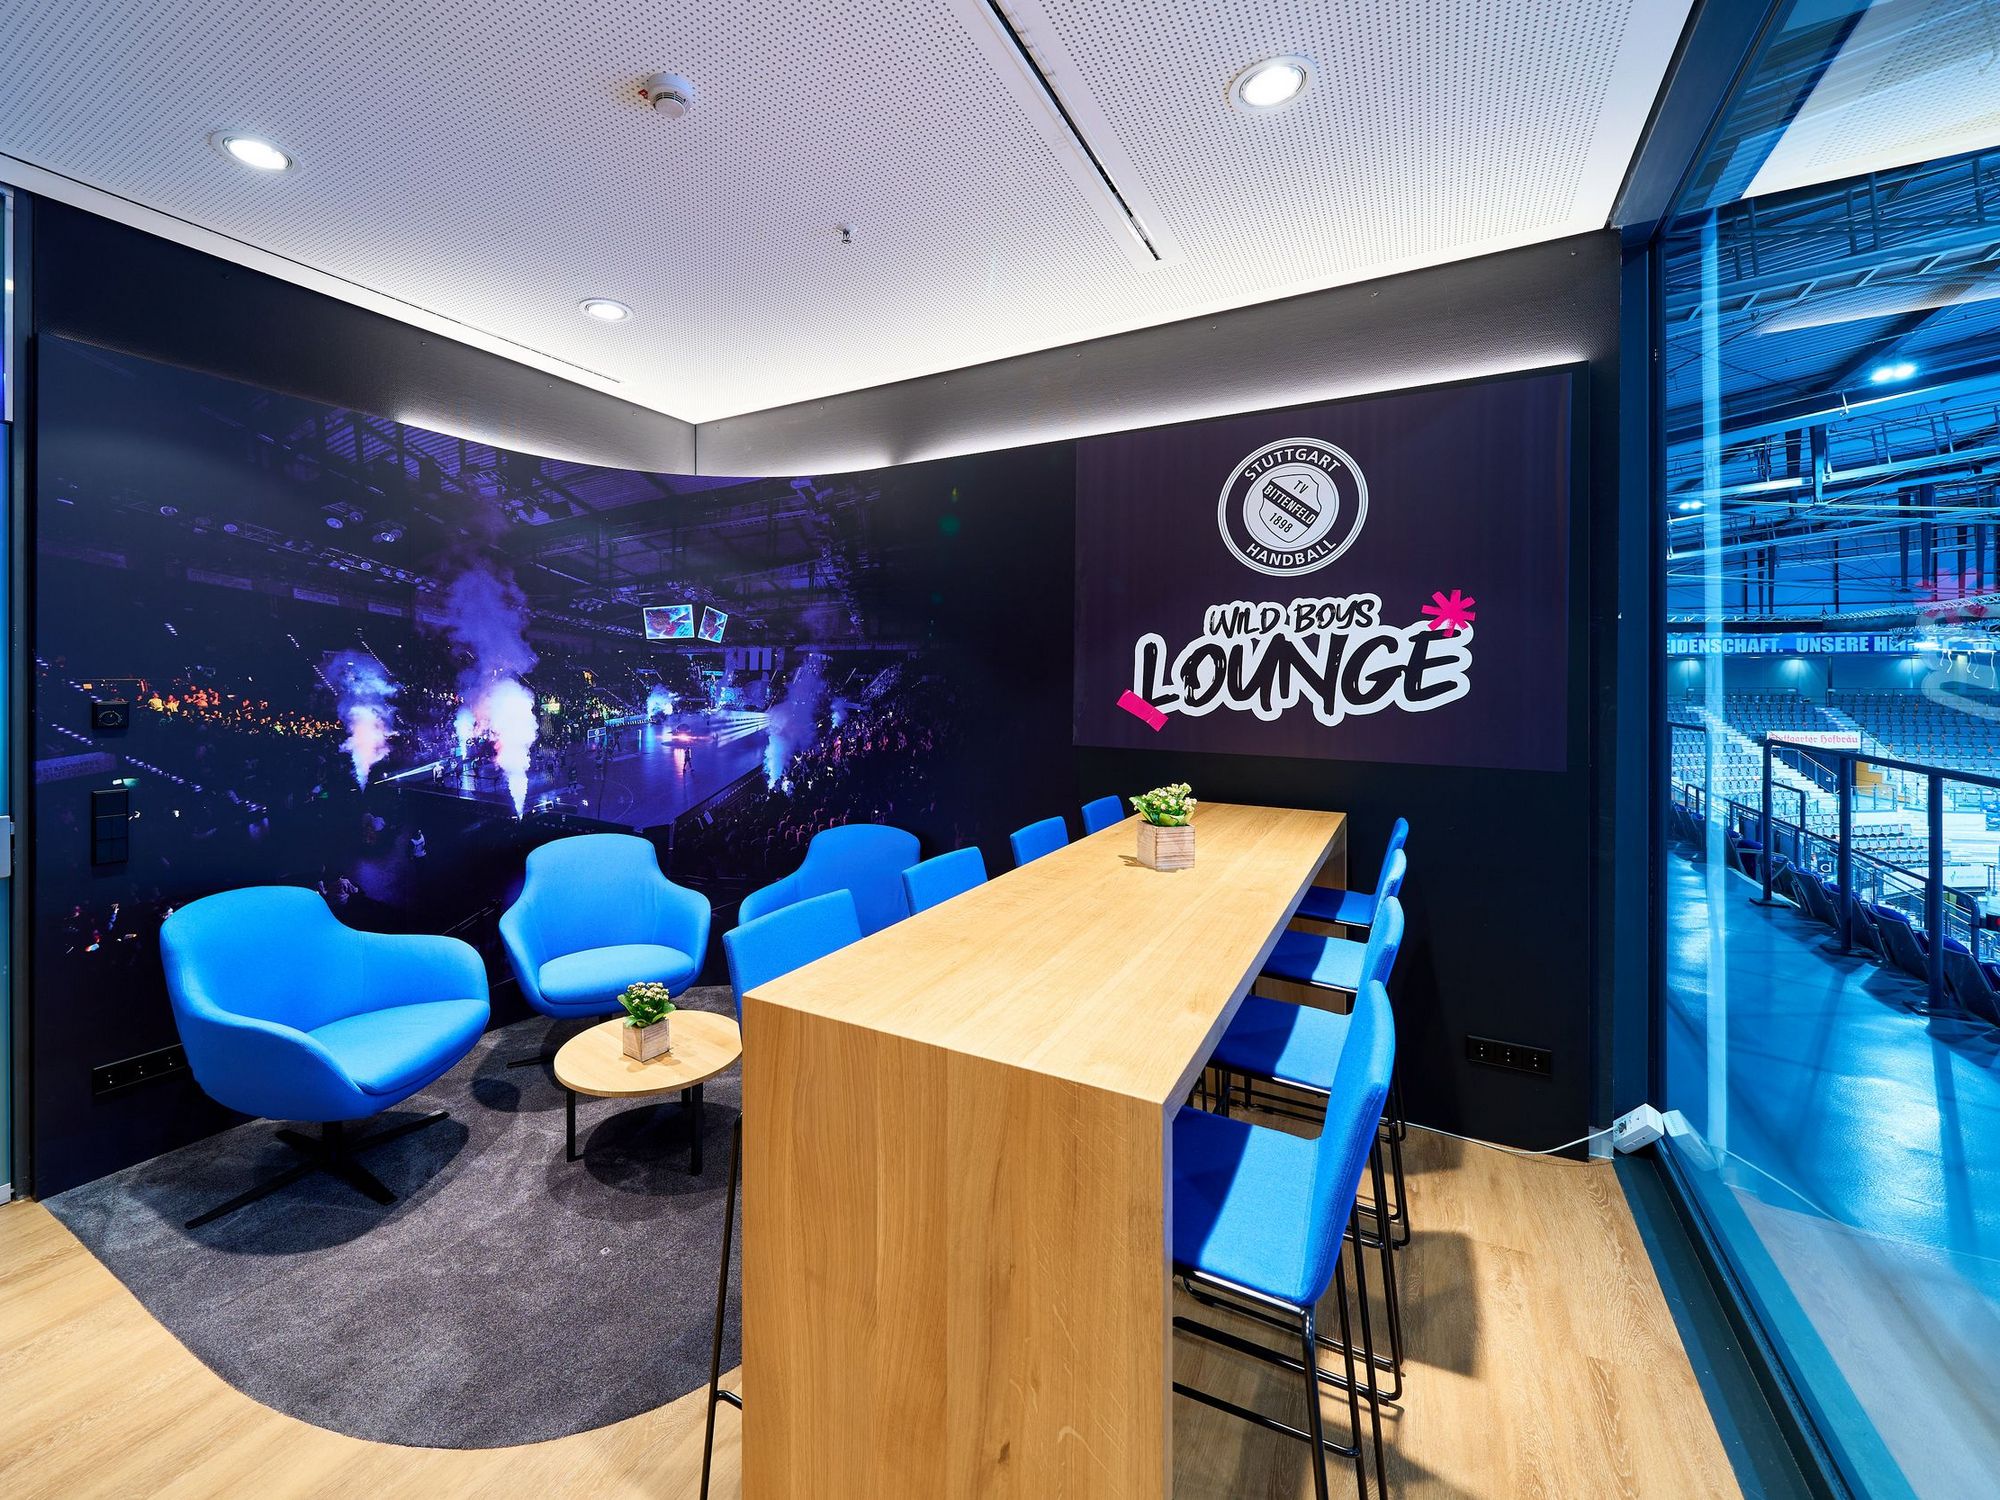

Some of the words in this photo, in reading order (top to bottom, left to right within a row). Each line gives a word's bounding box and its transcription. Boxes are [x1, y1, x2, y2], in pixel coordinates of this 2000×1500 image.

[1244, 448, 1341, 481] STUTTGART
[1293, 480, 1309, 494] TV
[1264, 484, 1317, 525] BITTENFELD
[1269, 512, 1294, 533] 1898
[1246, 539, 1337, 566] HANDBALL
[1209, 606, 1281, 638] WILD
[1294, 599, 1376, 633] BOYS
[1667, 638, 1784, 653] IDENSCHAFT.
[1796, 636, 1869, 652] UNSERE
[1141, 628, 1462, 716] LOUNGE
